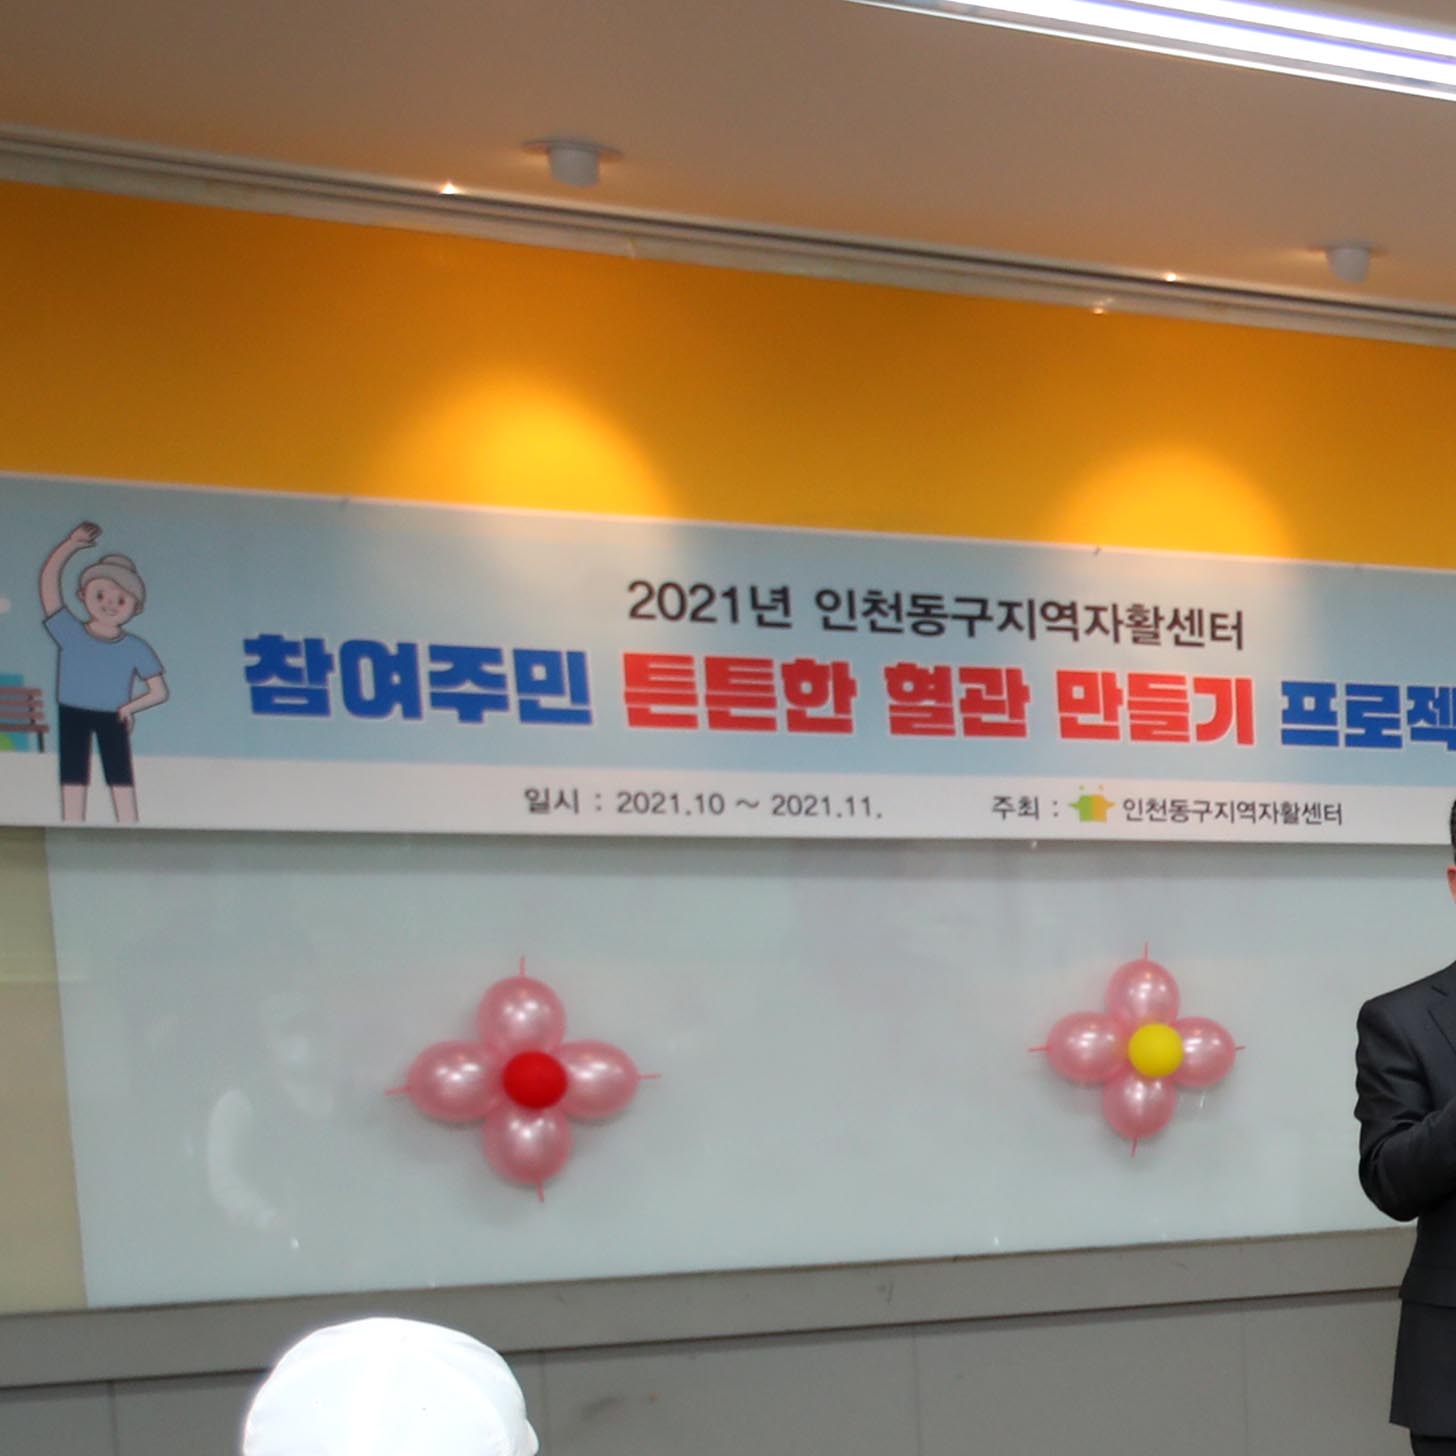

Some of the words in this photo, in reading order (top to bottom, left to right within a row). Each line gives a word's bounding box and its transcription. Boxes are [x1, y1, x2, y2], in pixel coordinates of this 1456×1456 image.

[627, 580, 793, 629] 2021년
[814, 587, 1245, 650] 인천동구지역자활센터
[243, 633, 593, 725] 참여주민
[622, 652, 858, 735] 튼튼한
[884, 661, 1031, 738] 혈관
[1056, 669, 1255, 746] 만들기
[524, 787, 580, 815] 일시
[616, 790, 726, 817] 2021.10
[771, 793, 884, 819] 2021.11.
[991, 795, 1040, 820] 주최
[1122, 797, 1344, 826] 인천동구지역자활센터
